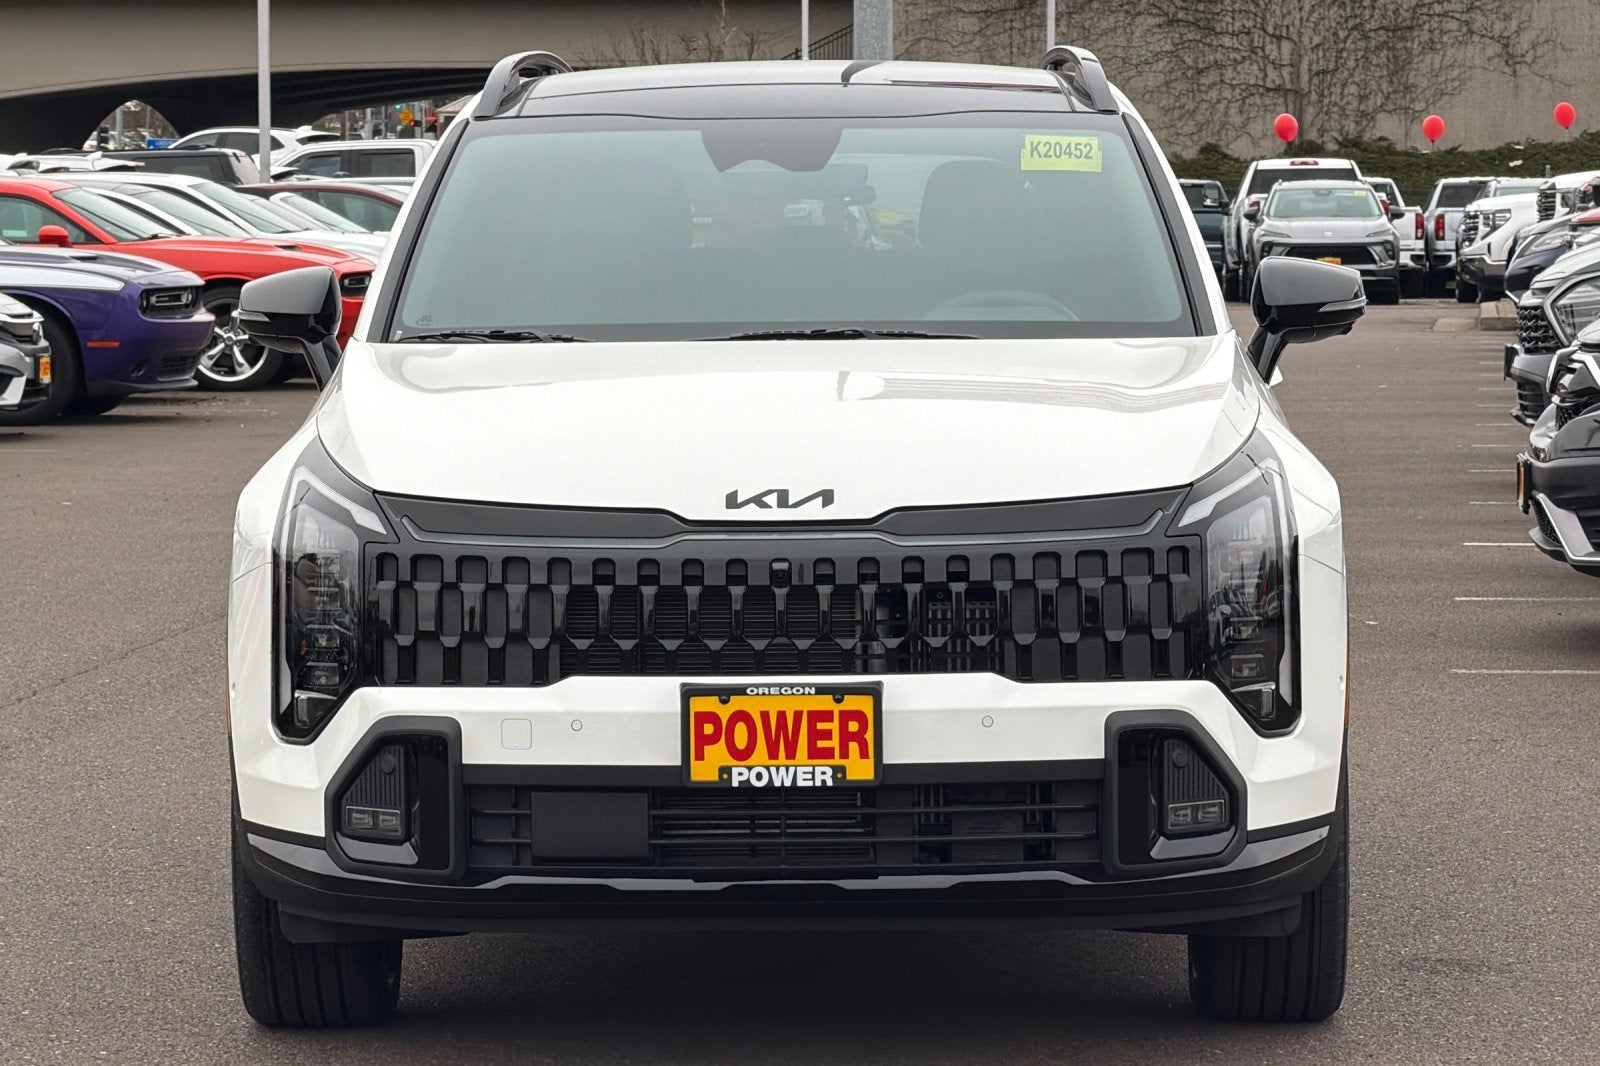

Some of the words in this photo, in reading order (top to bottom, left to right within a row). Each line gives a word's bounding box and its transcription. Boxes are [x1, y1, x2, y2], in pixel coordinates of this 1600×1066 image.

[1030, 141, 1094, 159] K20452
[725, 489, 834, 509] KIA
[746, 687, 816, 695] OREGON
[693, 709, 870, 762] POWER
[731, 766, 834, 787] POWER
